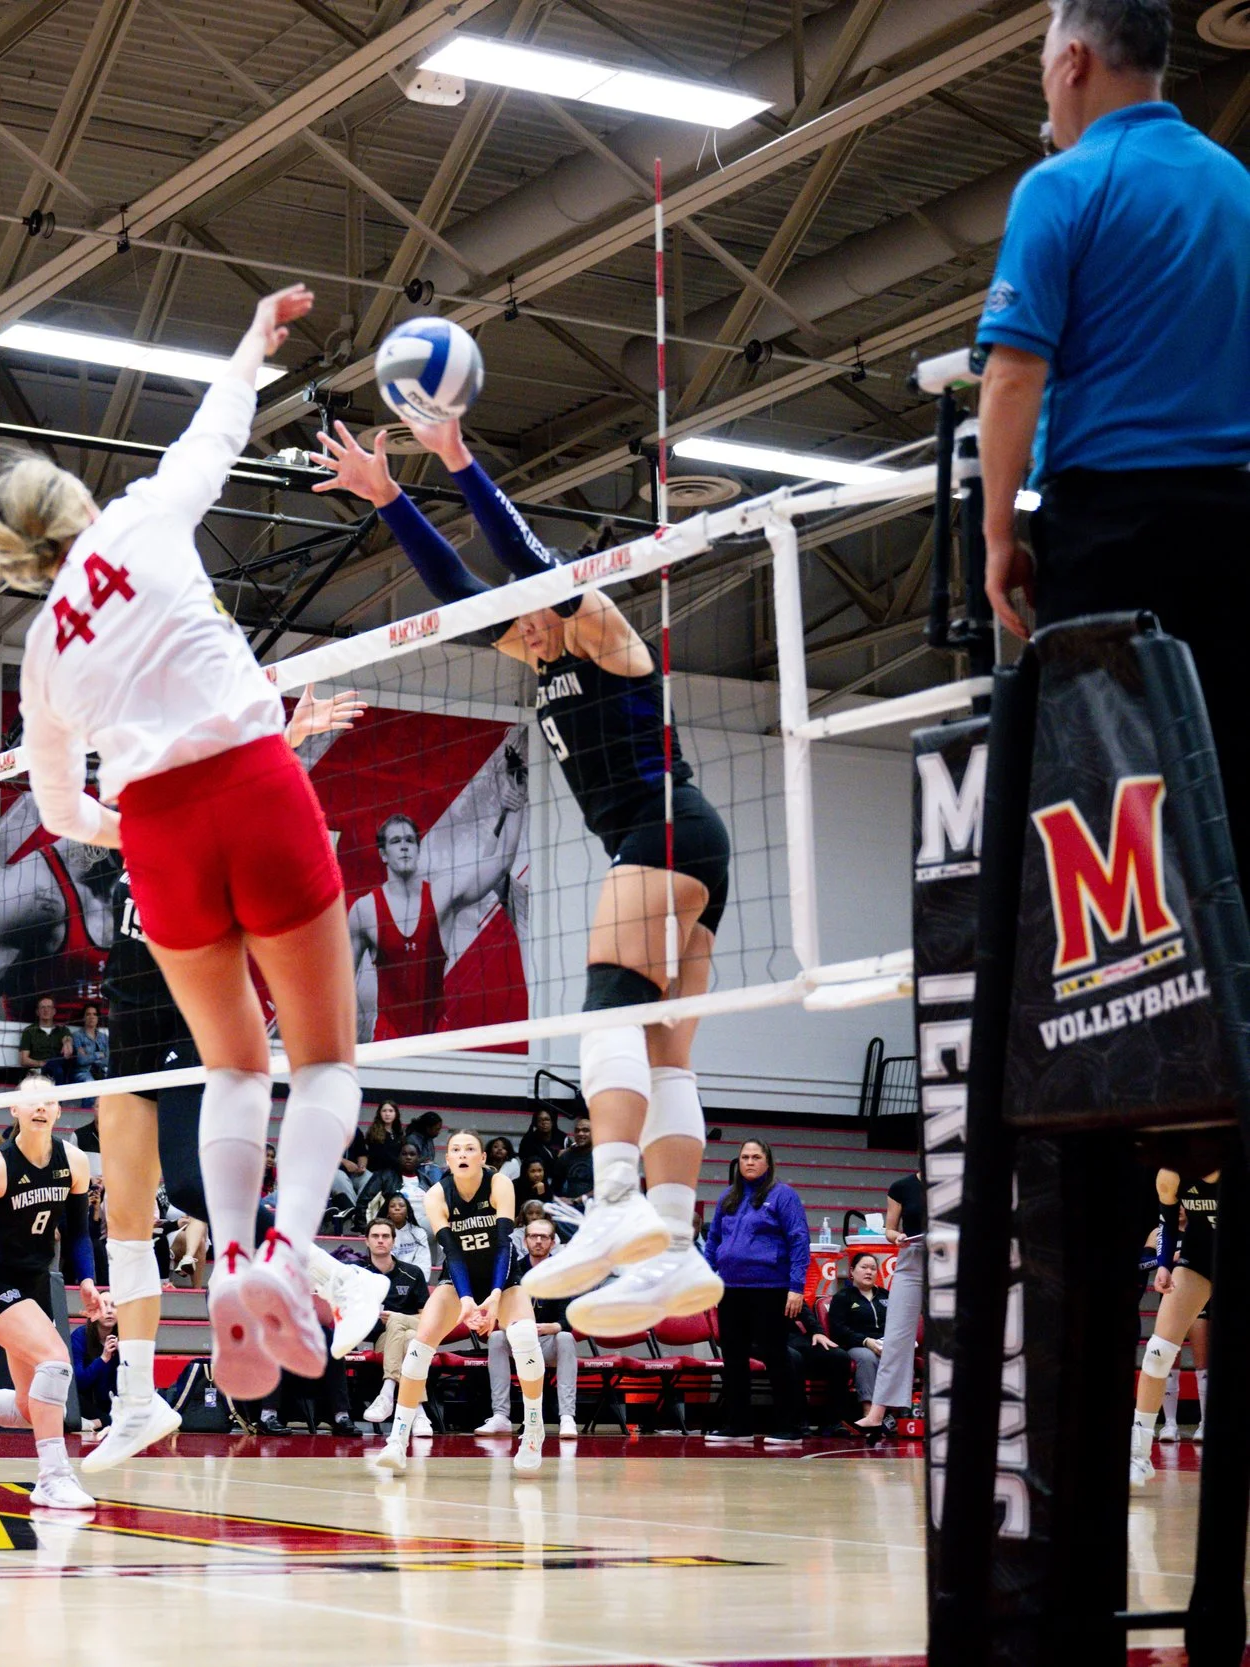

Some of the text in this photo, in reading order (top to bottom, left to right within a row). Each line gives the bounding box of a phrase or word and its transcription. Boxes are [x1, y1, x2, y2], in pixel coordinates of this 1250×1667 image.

[572, 547, 633, 583] MARYLAND
[52, 552, 136, 655] 44
[389, 611, 440, 644] MARYLAND
[541, 716, 570, 762] 9
[1032, 775, 1182, 975] M
[1038, 969, 1210, 1050] VOLLEYBALL
[11, 1187, 70, 1210] WASHINGTO
[31, 1210, 51, 1235] 8
[451, 1214, 497, 1232] ASHINGTON
[459, 1232, 490, 1251] 22
[821, 1262, 836, 1281] G
[906, 1421, 916, 1434] G
